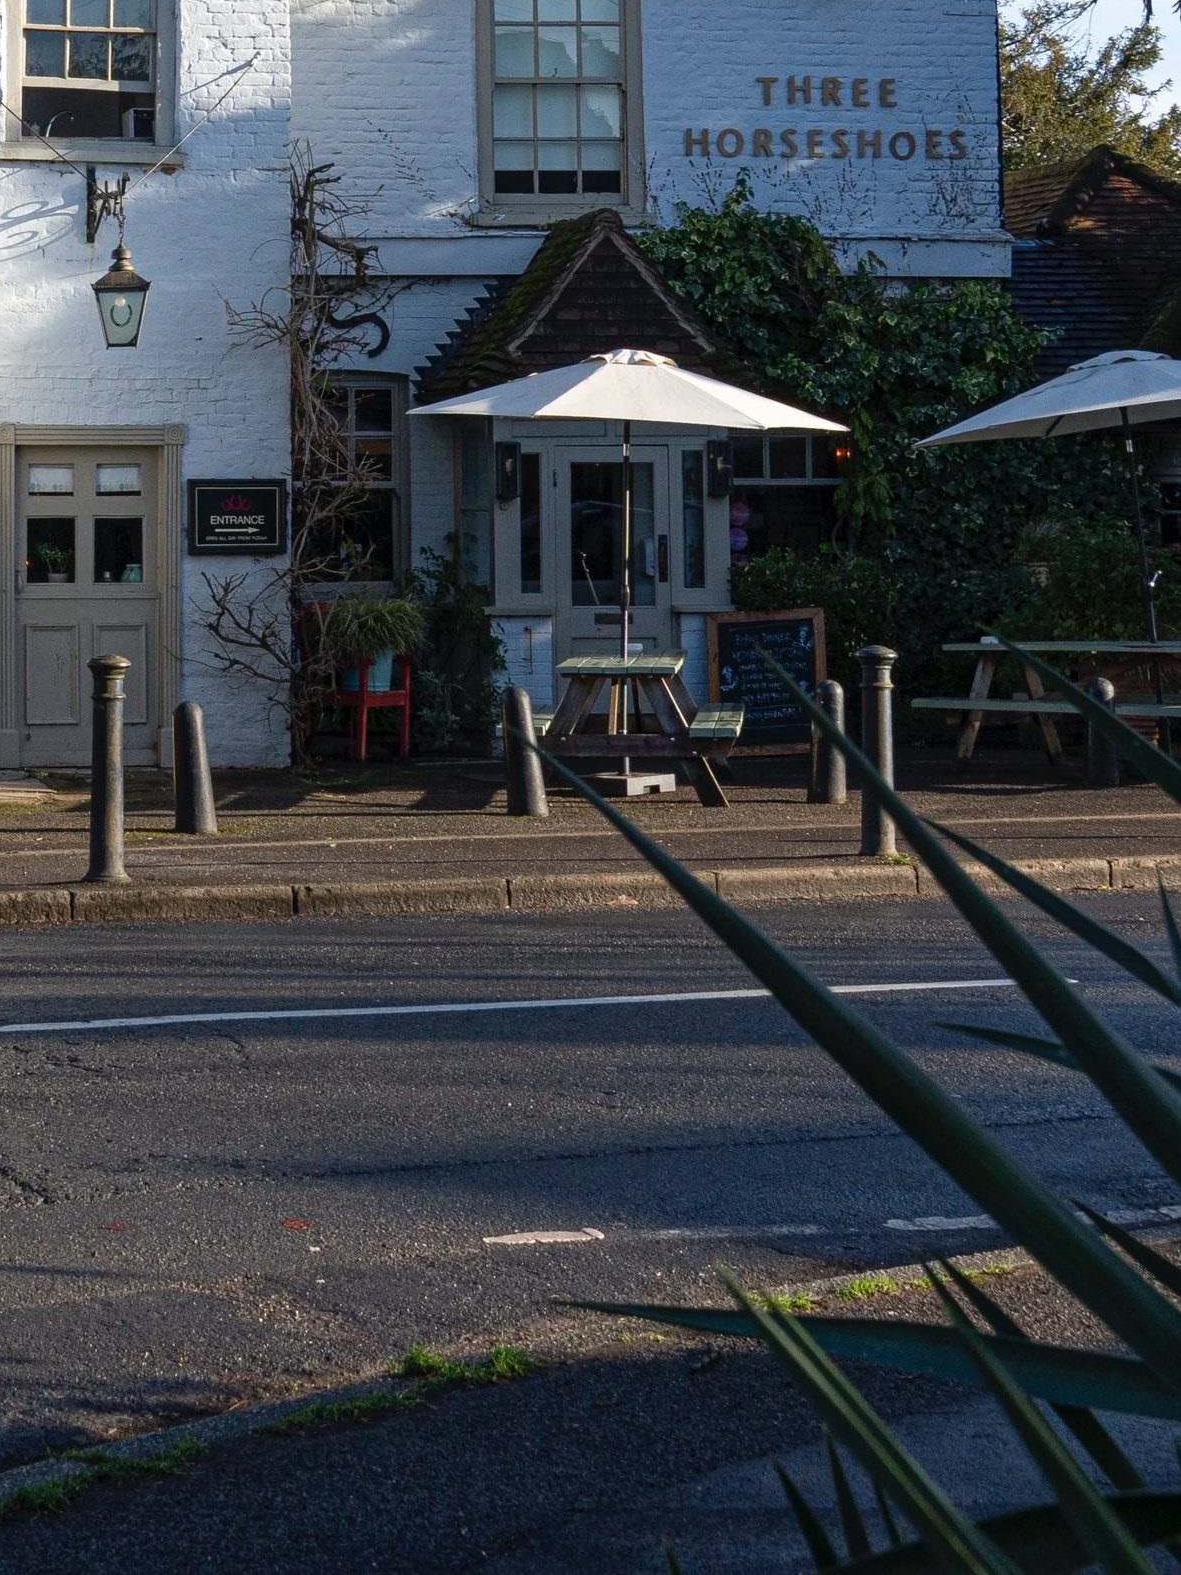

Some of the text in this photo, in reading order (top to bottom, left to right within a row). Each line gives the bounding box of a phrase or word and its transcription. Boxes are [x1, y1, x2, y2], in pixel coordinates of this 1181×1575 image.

[756, 75, 898, 108] THREE
[683, 127, 968, 161] HORSESHOES
[210, 515, 265, 525] ENTRANCE
